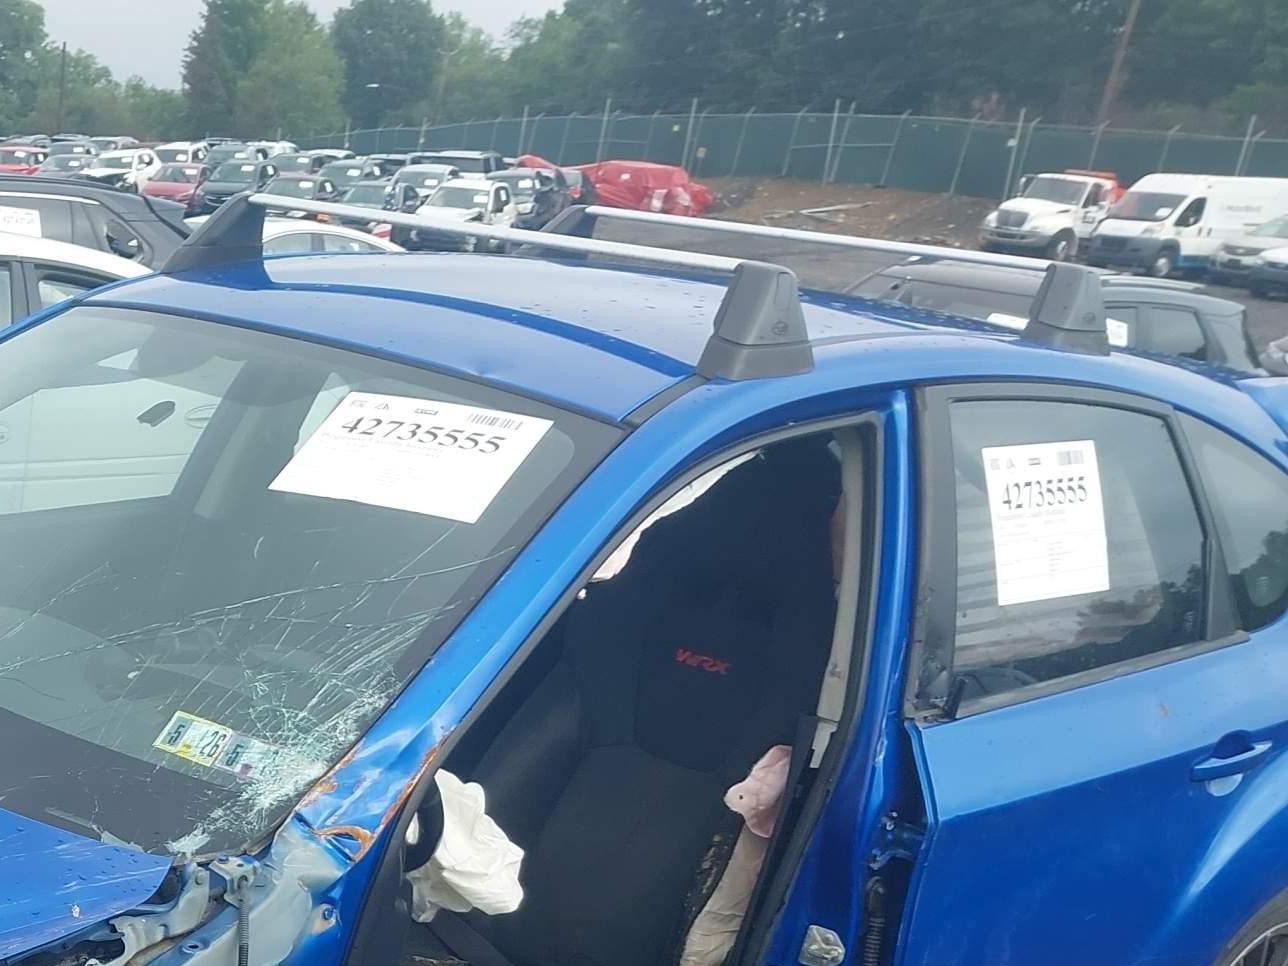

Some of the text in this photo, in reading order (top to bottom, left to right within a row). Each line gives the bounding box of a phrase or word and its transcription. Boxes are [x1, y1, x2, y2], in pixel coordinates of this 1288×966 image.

[341, 416, 508, 454] 42735555
[1002, 476, 1089, 511] 42735555
[675, 648, 730, 676] WRX
[199, 730, 227, 758] 26
